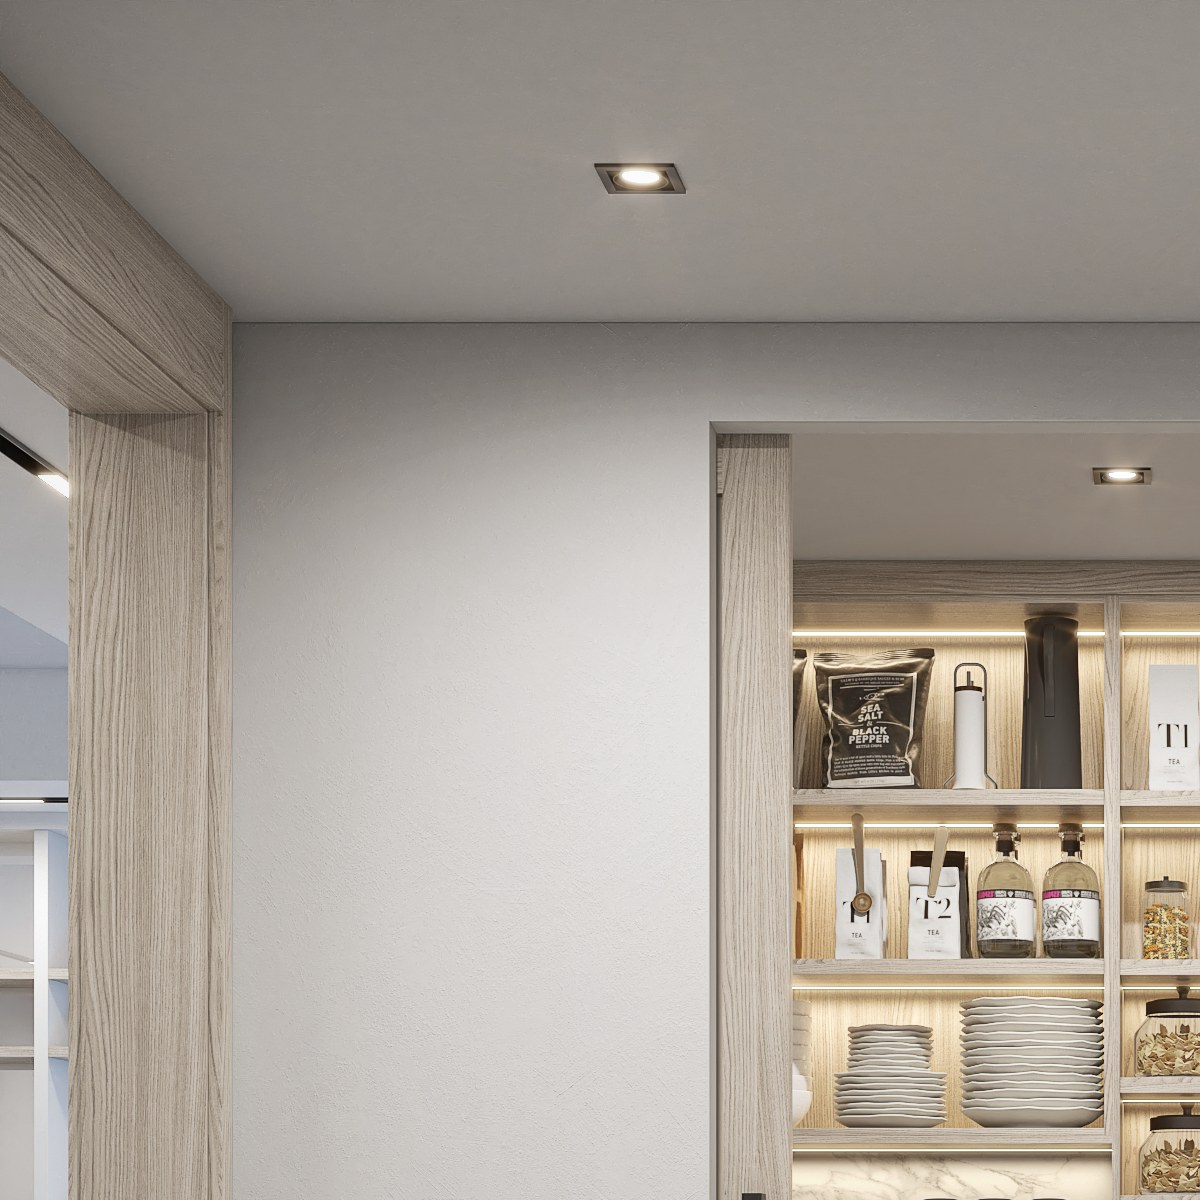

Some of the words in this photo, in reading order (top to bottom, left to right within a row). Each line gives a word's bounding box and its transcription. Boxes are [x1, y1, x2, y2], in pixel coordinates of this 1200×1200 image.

[861, 704, 880, 714] SEA
[858, 711, 883, 722] SALT
[852, 726, 887, 736] BLACK
[849, 735, 889, 744] PEPPER
[916, 897, 952, 919] T2
